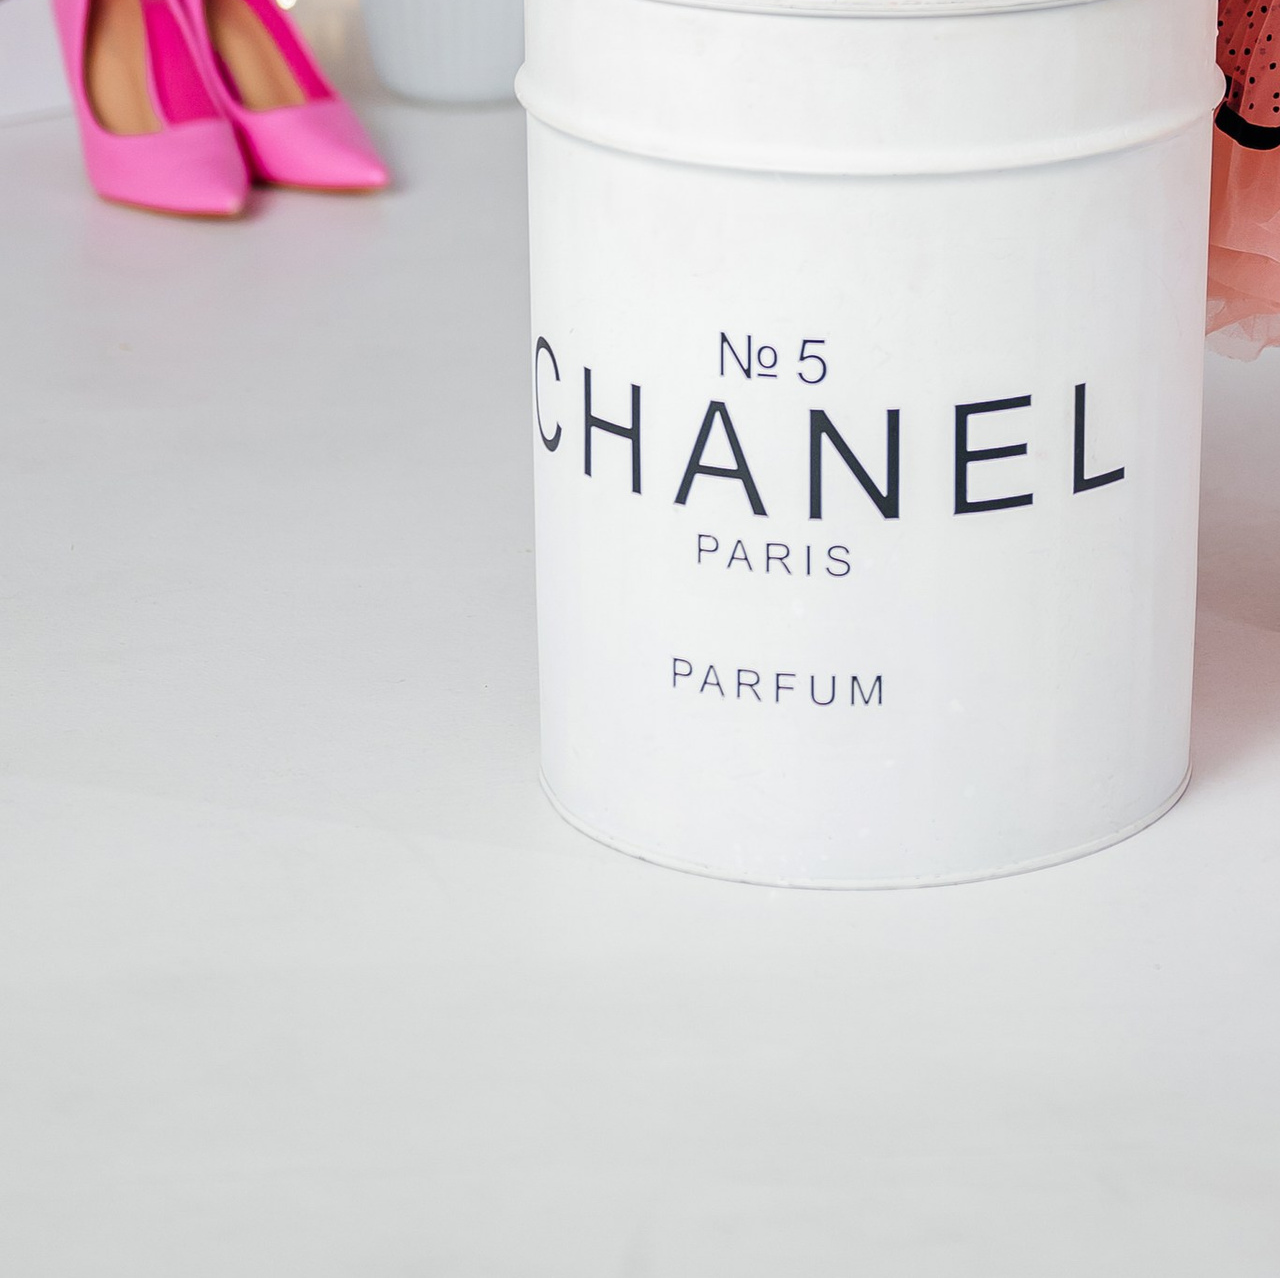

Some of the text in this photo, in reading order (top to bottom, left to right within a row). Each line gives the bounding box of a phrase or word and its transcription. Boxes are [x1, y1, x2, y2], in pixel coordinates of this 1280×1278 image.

[796, 338, 829, 385] 5
[534, 334, 1126, 522] CHANEL
[696, 533, 852, 578] PARIS
[671, 656, 884, 707] PARFUM
